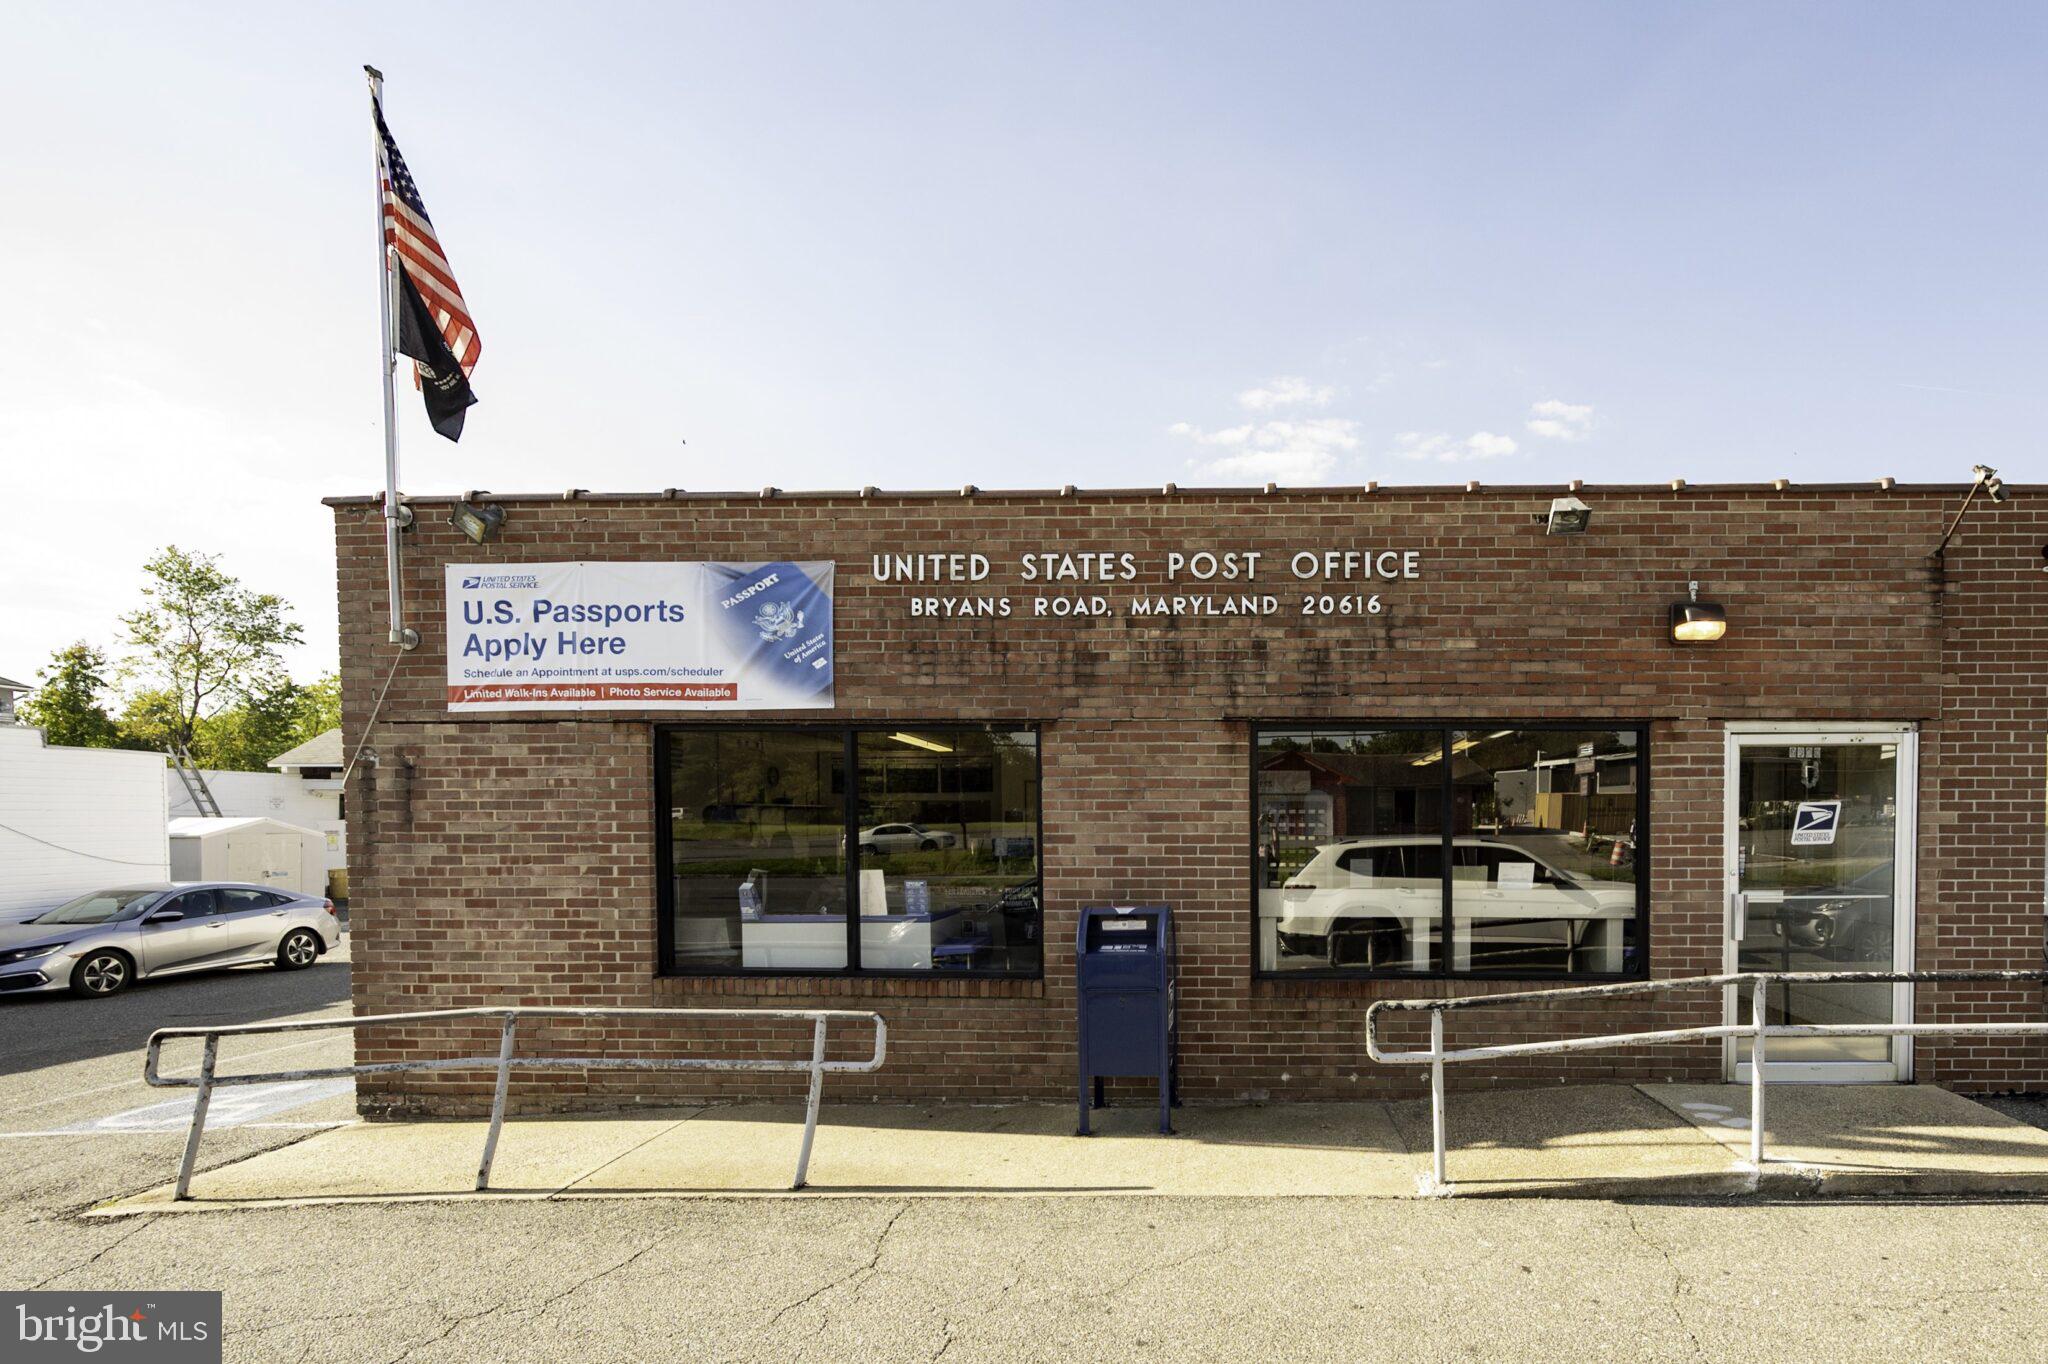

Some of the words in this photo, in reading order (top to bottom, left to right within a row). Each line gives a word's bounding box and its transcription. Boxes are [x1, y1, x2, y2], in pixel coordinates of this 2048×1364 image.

[873, 553, 990, 582] UNITED
[1021, 552, 1137, 581] STATES
[1168, 551, 1262, 580] POST
[1291, 551, 1420, 580] OFFICE
[721, 573, 780, 610] PASSPORT
[463, 600, 521, 625] U.S.
[533, 599, 685, 628] Passports
[911, 597, 1011, 617] BRYANS
[1034, 596, 1112, 618] ROAD,
[1131, 595, 1278, 616] MARYLAND
[1302, 594, 1382, 615] 20616
[463, 632, 547, 662] Apply
[558, 631, 626, 655] Here
[783, 642, 807, 659] United
[806, 633, 825, 647] States
[794, 655, 802, 664] of
[801, 640, 826, 658] America
[463, 668, 513, 678] Schedule
[531, 667, 598, 678] Appointment
[601, 667, 611, 676] at
[615, 667, 724, 678] usps.com/scheduler
[463, 688, 502, 699] Limited
[504, 687, 548, 698] Walk-Ins
[550, 687, 596, 697] Available
[609, 687, 641, 697] Photo
[643, 687, 682, 697] Service
[684, 687, 731, 697] Available
